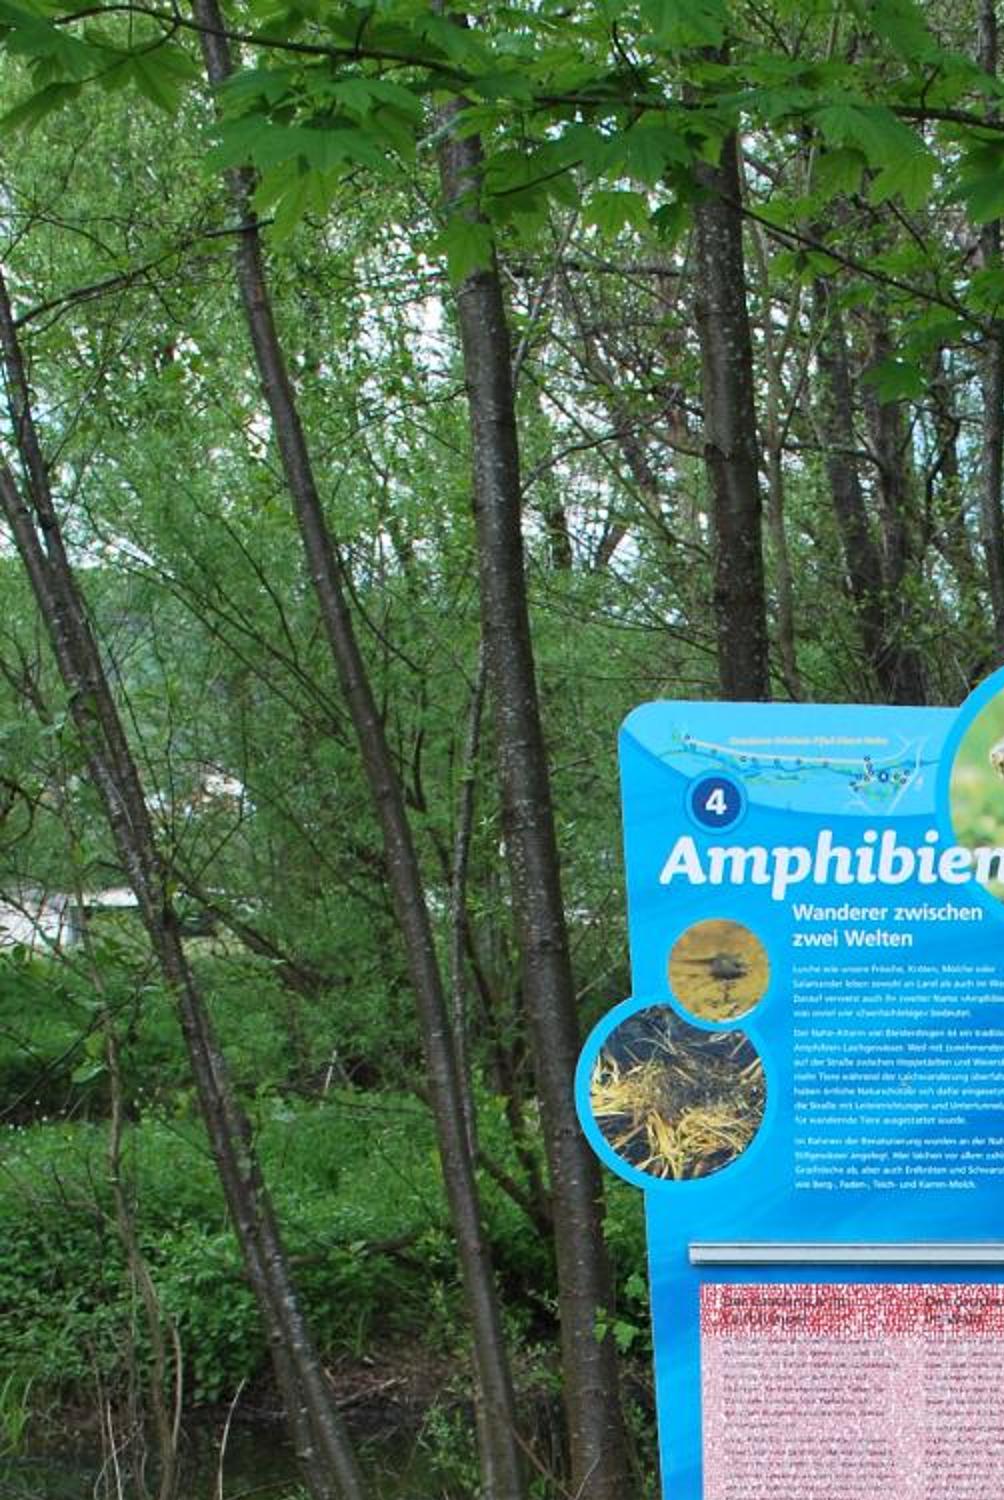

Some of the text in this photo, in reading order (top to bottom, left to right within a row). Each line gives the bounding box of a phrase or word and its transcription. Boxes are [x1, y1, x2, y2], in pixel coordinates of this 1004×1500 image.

[705, 789, 728, 815] 4
[792, 903, 983, 921] Wanderer zwischen
[792, 929, 913, 948] zwei Welten
